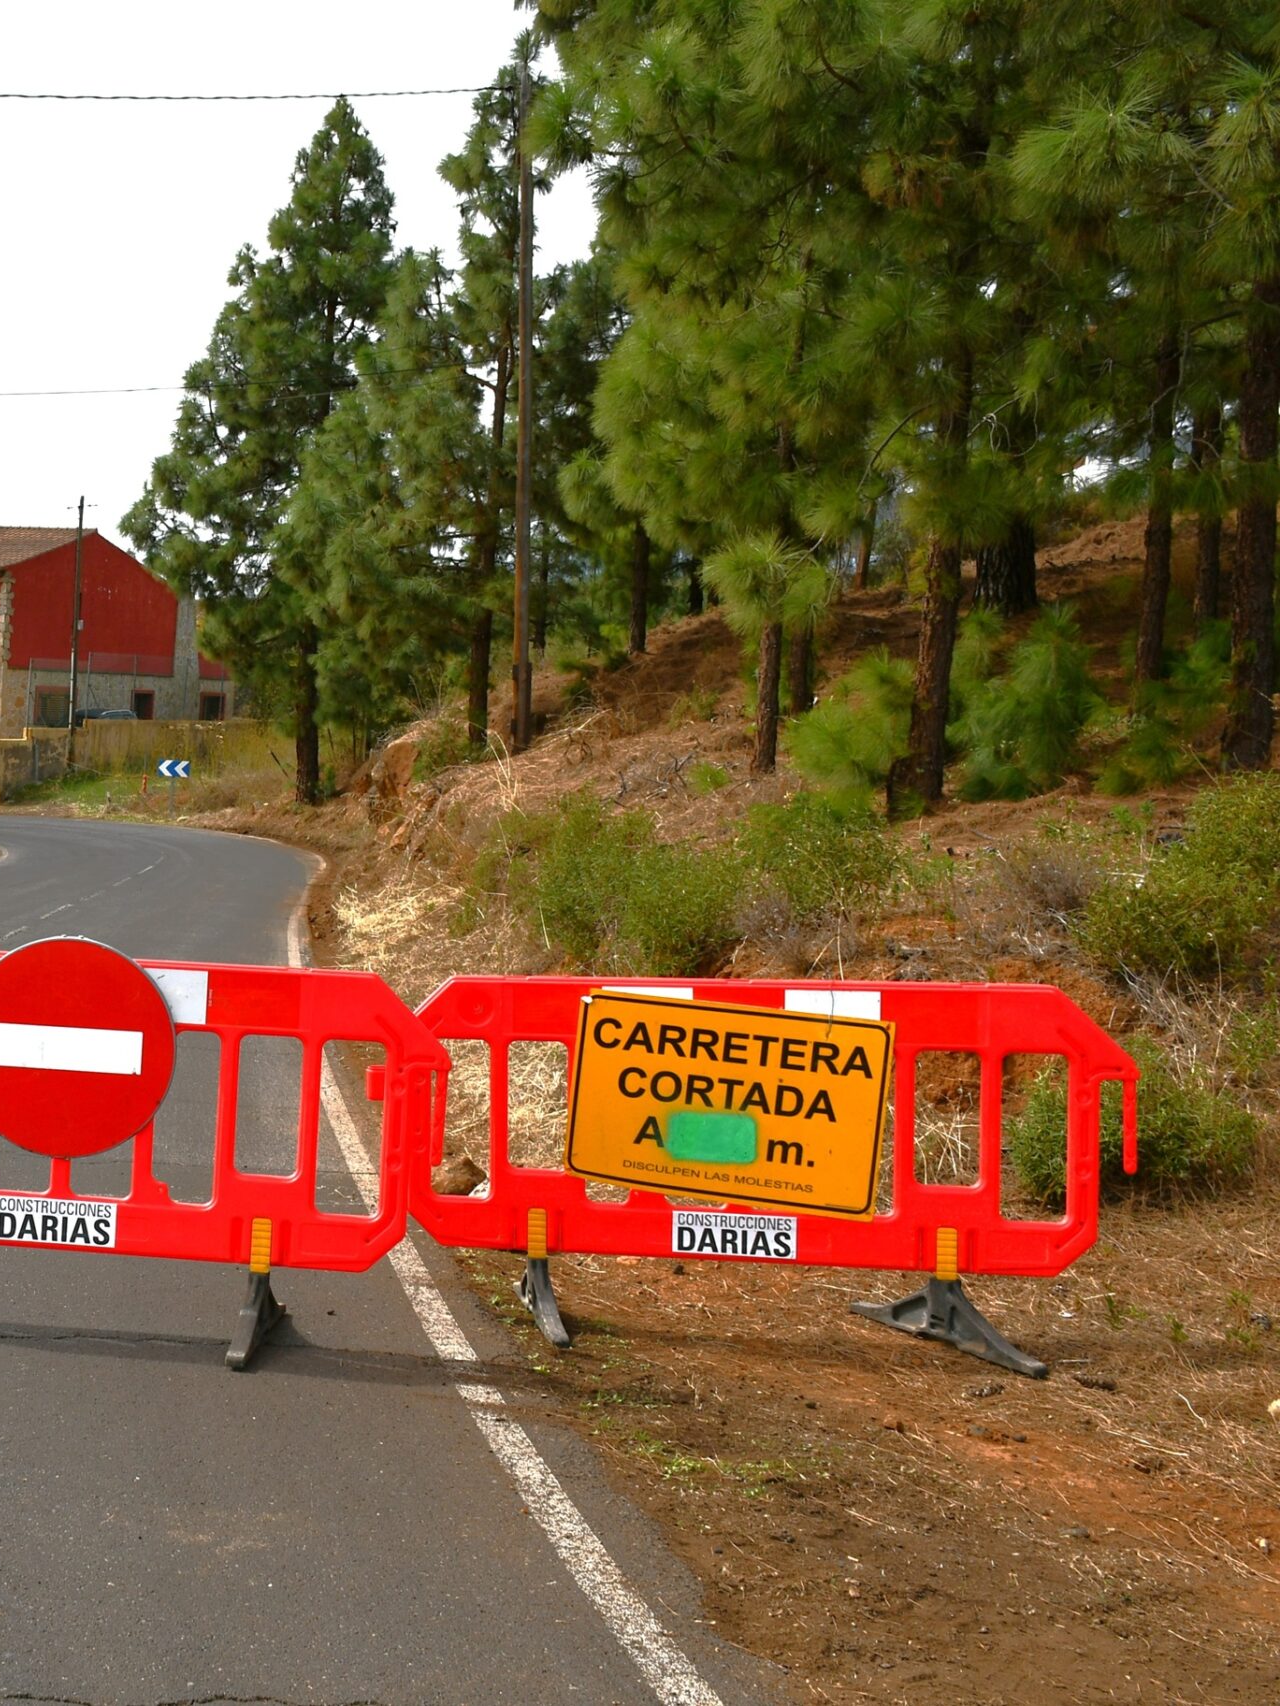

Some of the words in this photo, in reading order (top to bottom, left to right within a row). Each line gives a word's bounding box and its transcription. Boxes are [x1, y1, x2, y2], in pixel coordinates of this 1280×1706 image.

[593, 1017, 873, 1079] CARRETERA
[618, 1066, 837, 1123] CORTADA
[633, 1115, 665, 1148] A
[766, 1138, 815, 1168] m.
[622, 1159, 701, 1179] DISCULPEN
[704, 1171, 730, 1183] LAS
[734, 1175, 814, 1193] MOLESTIAS
[677, 1212, 793, 1232] CONSTRUCCIONES
[677, 1226, 792, 1258] DARIAS
